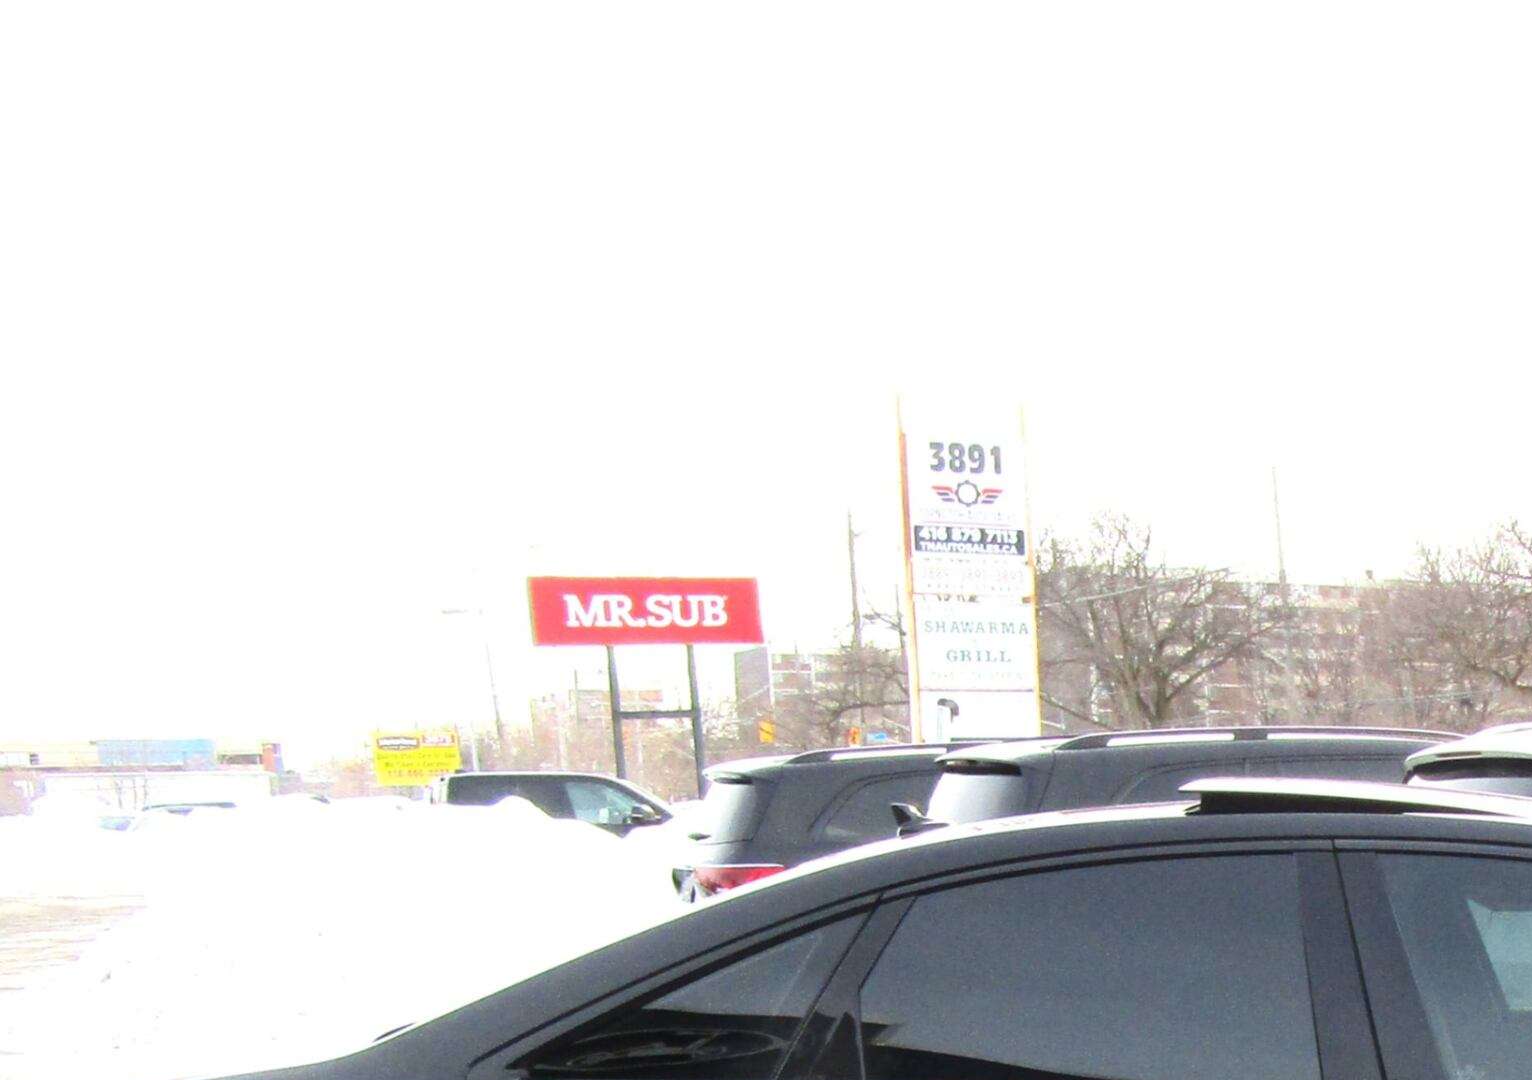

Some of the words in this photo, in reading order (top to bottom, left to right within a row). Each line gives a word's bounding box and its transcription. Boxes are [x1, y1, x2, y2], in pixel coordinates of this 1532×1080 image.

[929, 442, 1002, 475] 3891
[918, 526, 948, 542] 416
[563, 594, 728, 628] MR.SUB
[924, 620, 1029, 635] SHAWARMA
[946, 649, 1012, 663] GRILL
